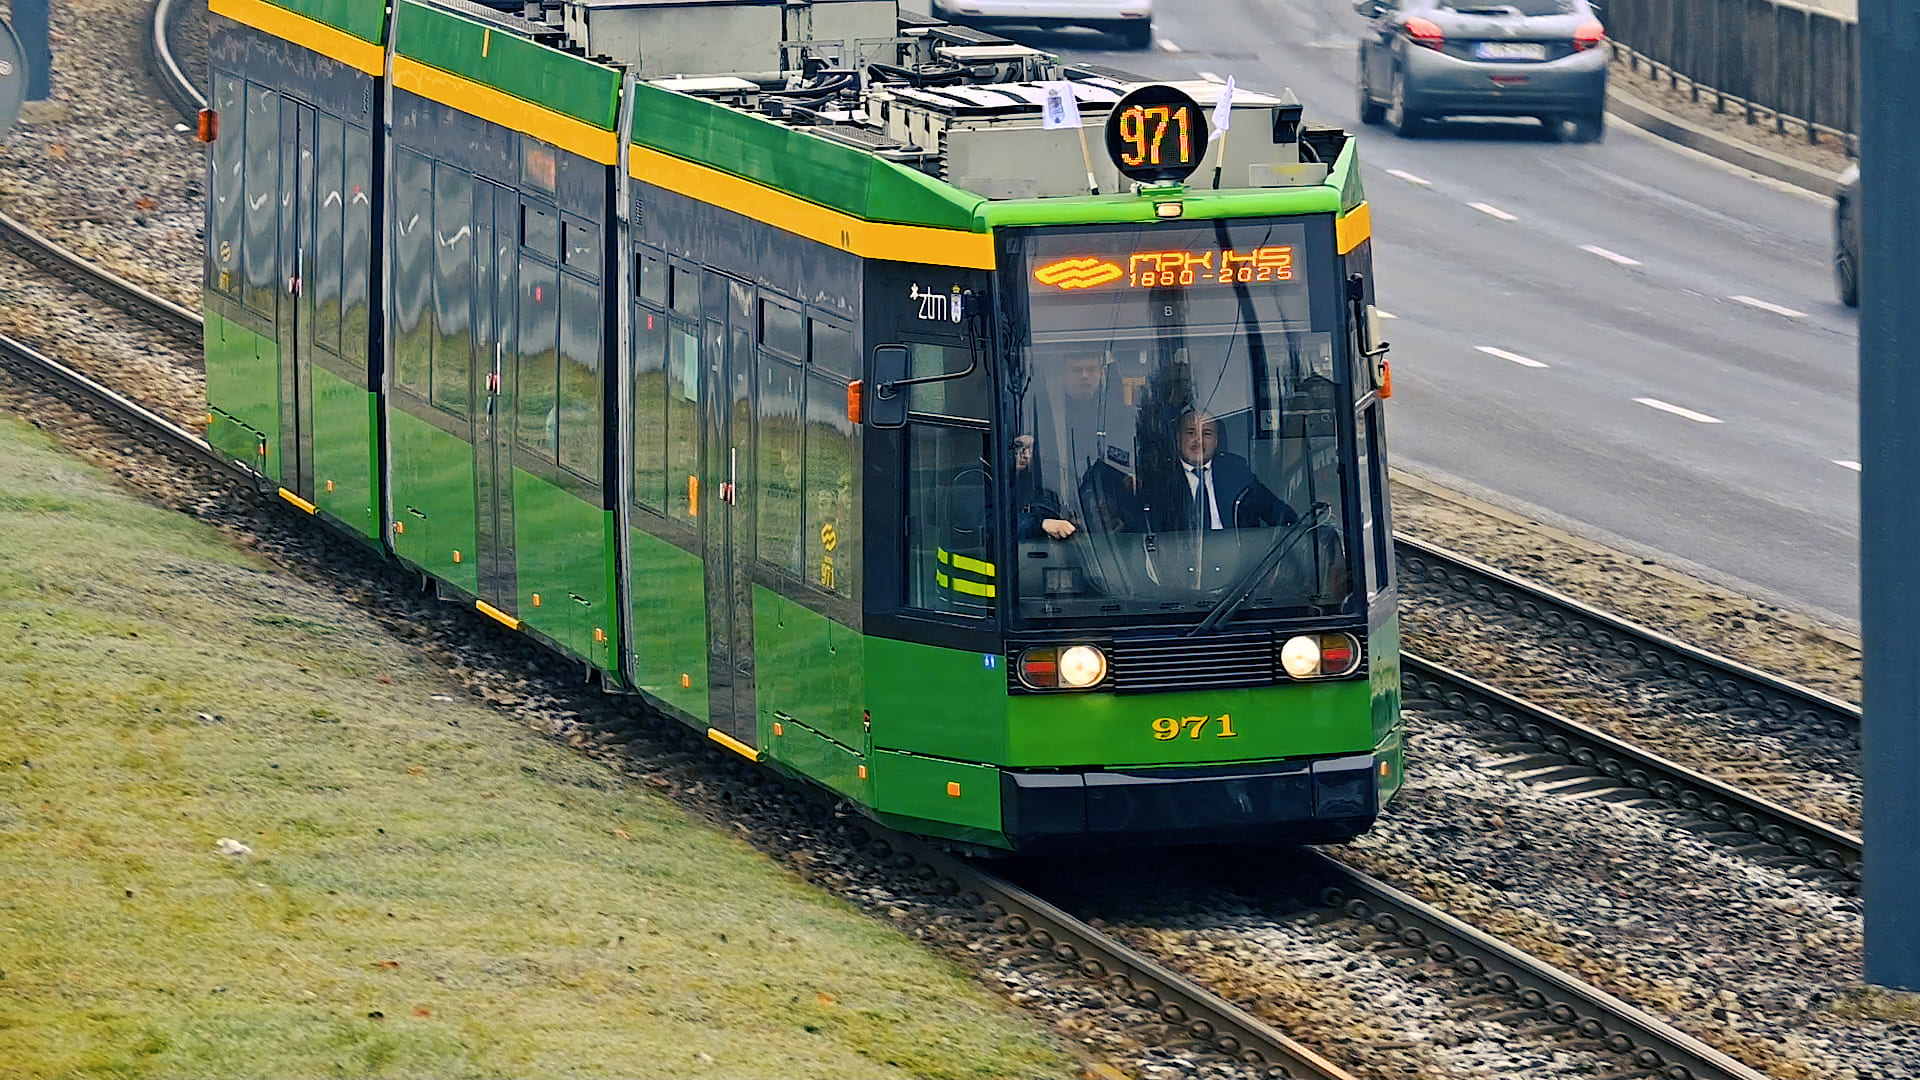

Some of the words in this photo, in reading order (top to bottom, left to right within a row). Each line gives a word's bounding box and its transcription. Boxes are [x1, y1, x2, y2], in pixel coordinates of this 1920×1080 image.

[1120, 106, 1189, 166] 971
[1222, 246, 1293, 268] 145
[1129, 265, 1293, 288] 1880-2025
[1151, 713, 1239, 741] 971
